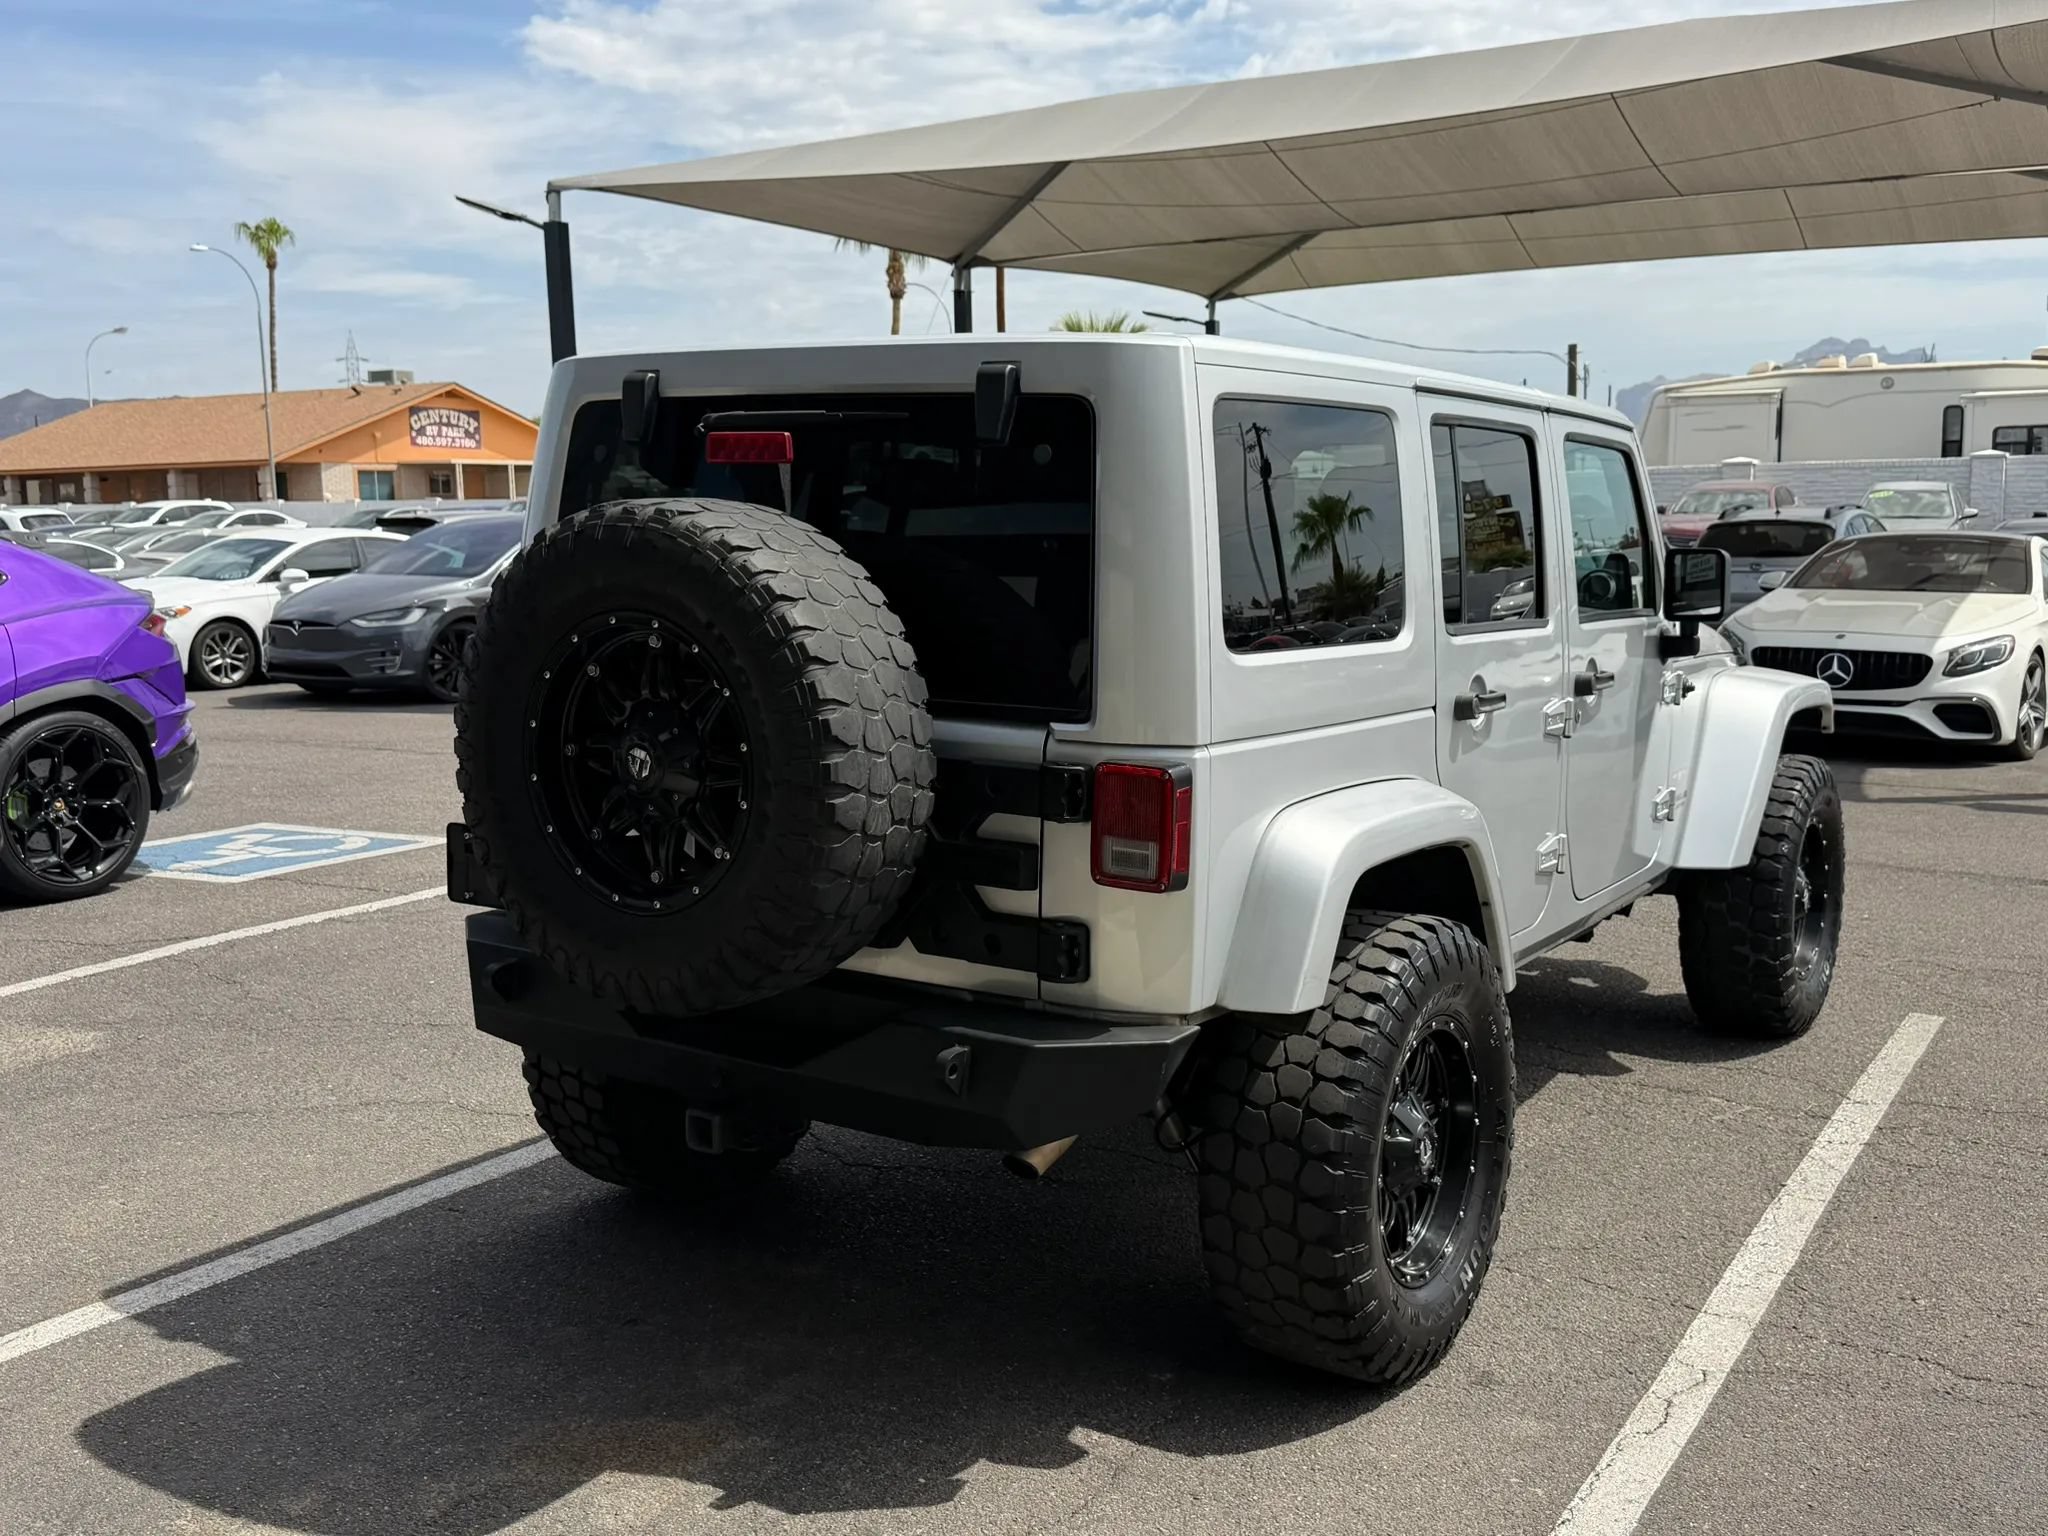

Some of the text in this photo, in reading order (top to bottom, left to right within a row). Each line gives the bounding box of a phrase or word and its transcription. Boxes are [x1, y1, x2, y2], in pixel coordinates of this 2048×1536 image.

[410, 408, 478, 434] CENTURY
[425, 425, 466, 438] RV PARK
